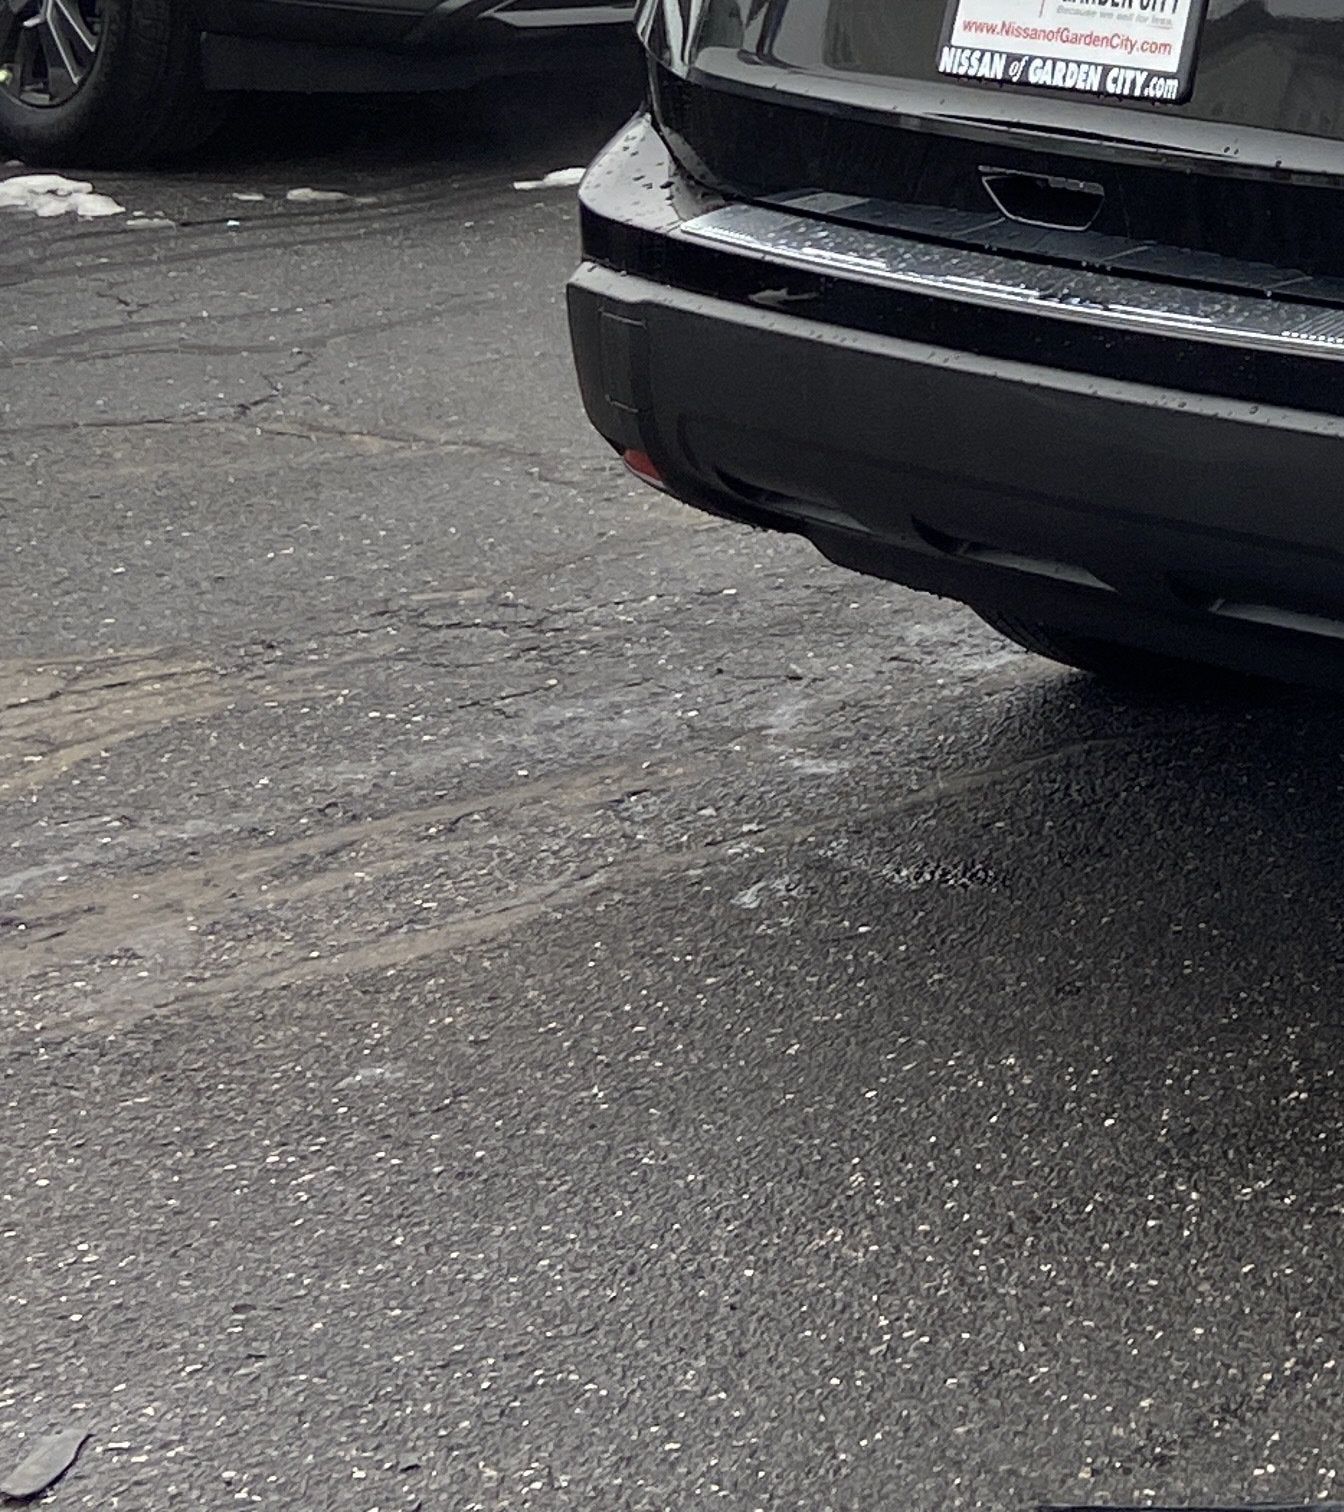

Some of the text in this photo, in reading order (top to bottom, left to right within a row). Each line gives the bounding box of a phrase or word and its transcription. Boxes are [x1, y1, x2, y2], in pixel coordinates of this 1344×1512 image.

[962, 19, 1173, 56] www.NissanofGardenCity.com
[938, 46, 1180, 100] NISSAN of GARDEN CITY.com
